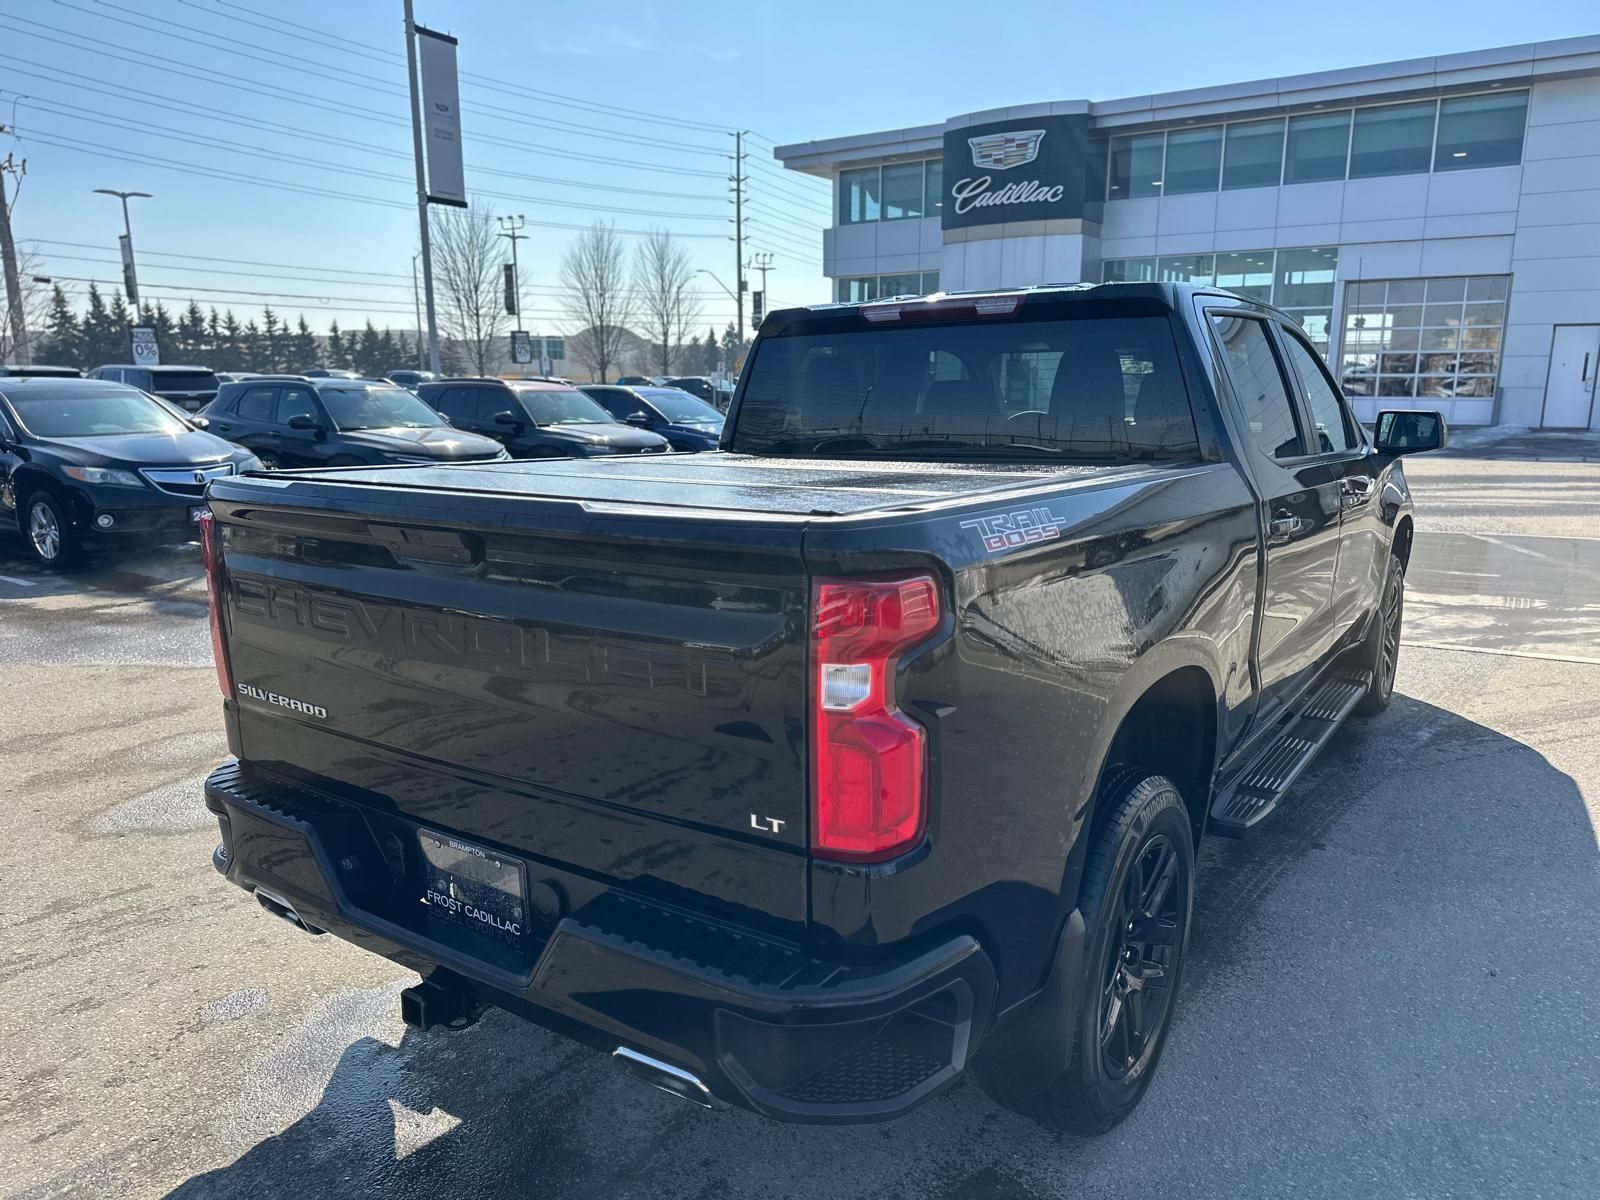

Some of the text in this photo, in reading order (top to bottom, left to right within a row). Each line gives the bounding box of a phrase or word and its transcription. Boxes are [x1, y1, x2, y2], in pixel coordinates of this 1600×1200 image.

[951, 175, 1065, 214] Cadillac
[135, 343, 158, 357] 0%
[959, 507, 1067, 537] TRAIL
[982, 524, 1061, 553] BOSS
[237, 683, 327, 719] SILVERADO
[750, 812, 786, 834] LT
[448, 840, 486, 858] BRAMPTON
[427, 890, 463, 912] FROST
[464, 904, 521, 936] CADILLAC
